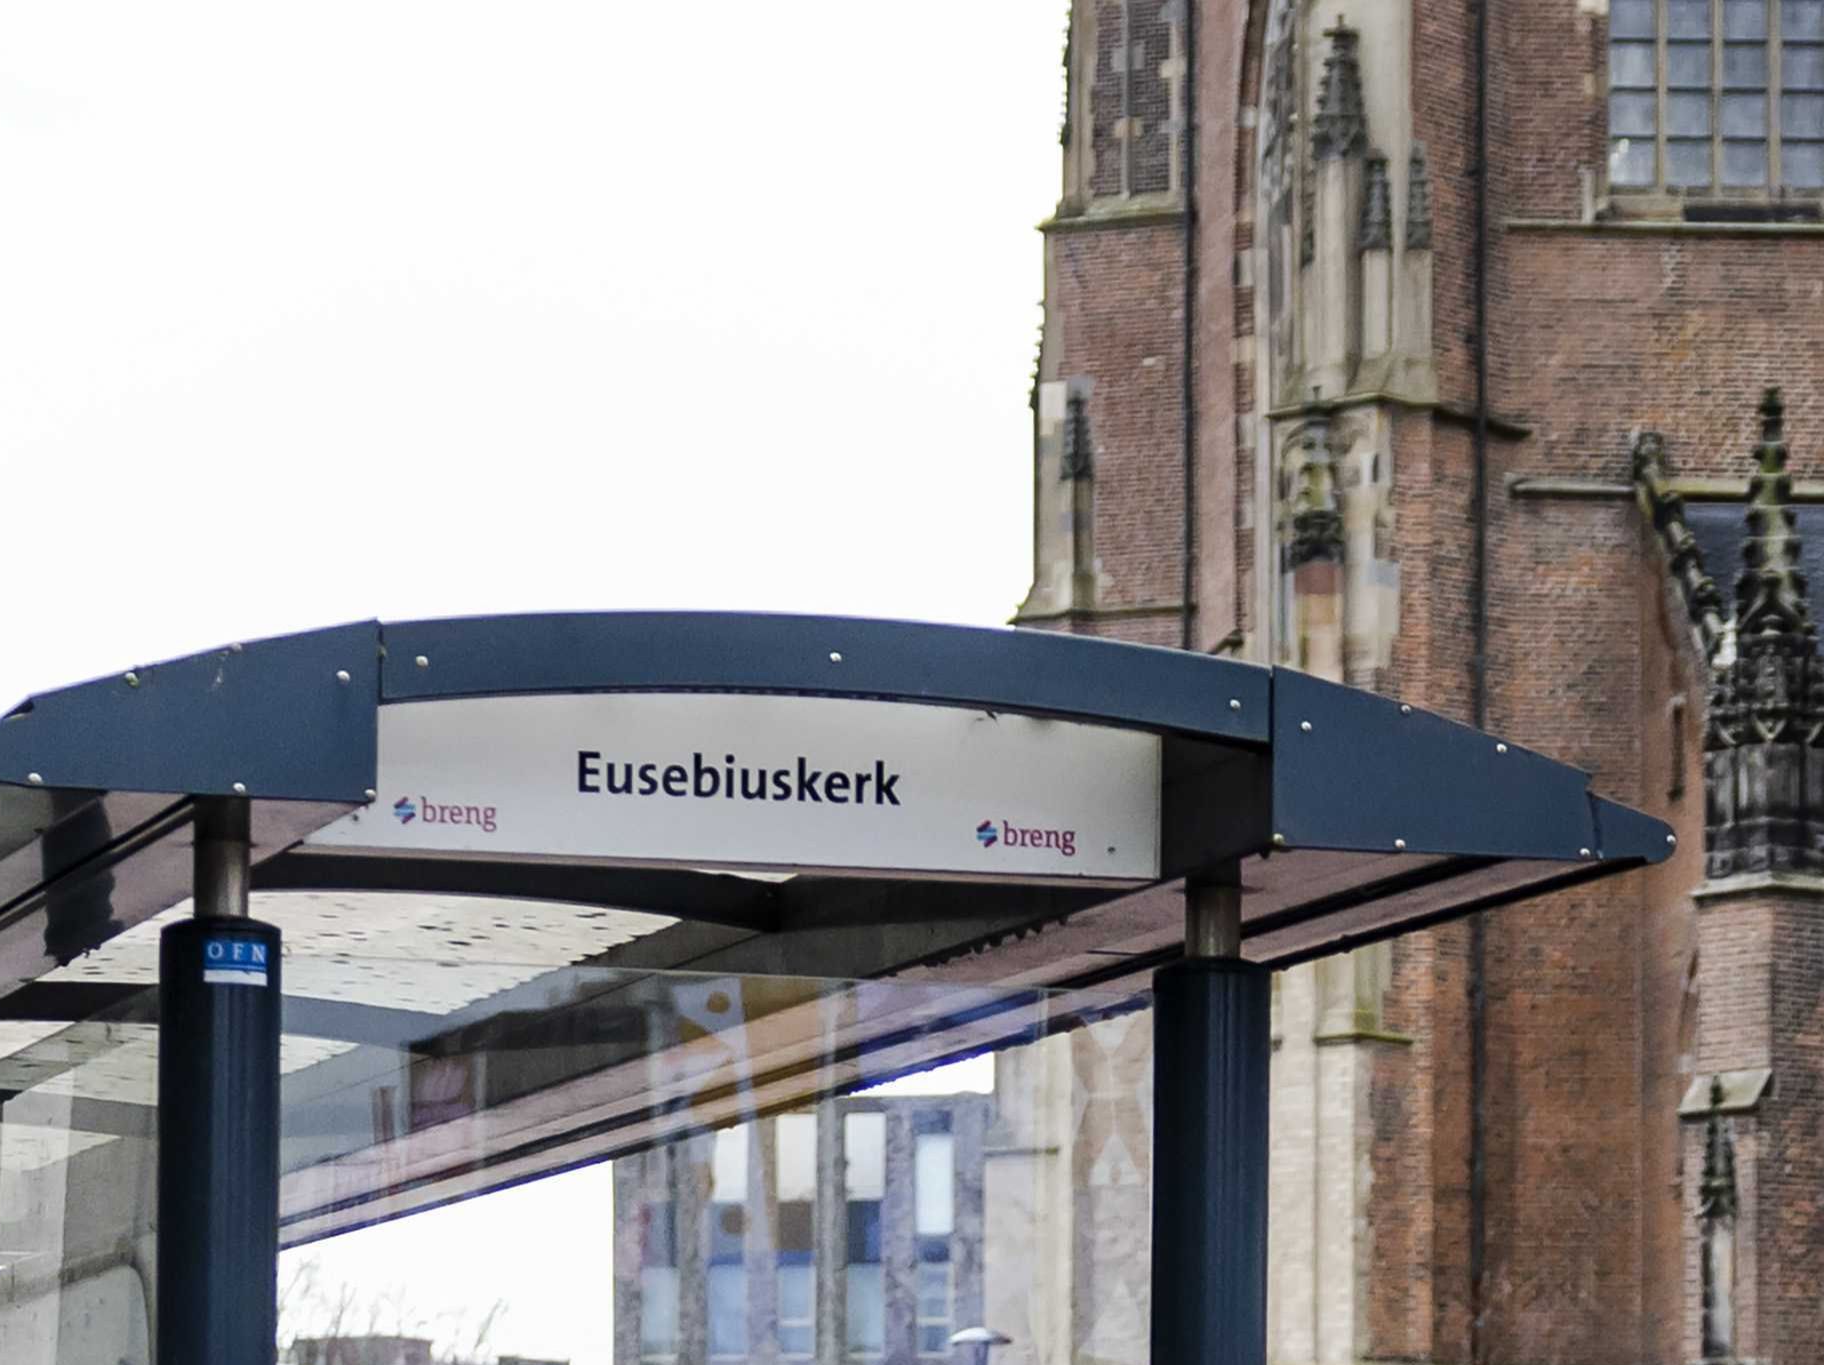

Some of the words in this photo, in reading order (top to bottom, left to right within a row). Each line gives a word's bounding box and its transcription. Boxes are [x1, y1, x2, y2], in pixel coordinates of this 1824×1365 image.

[577, 750, 901, 806] Eusebiuskerk
[420, 796, 497, 832] breng
[1003, 820, 1076, 857] breng
